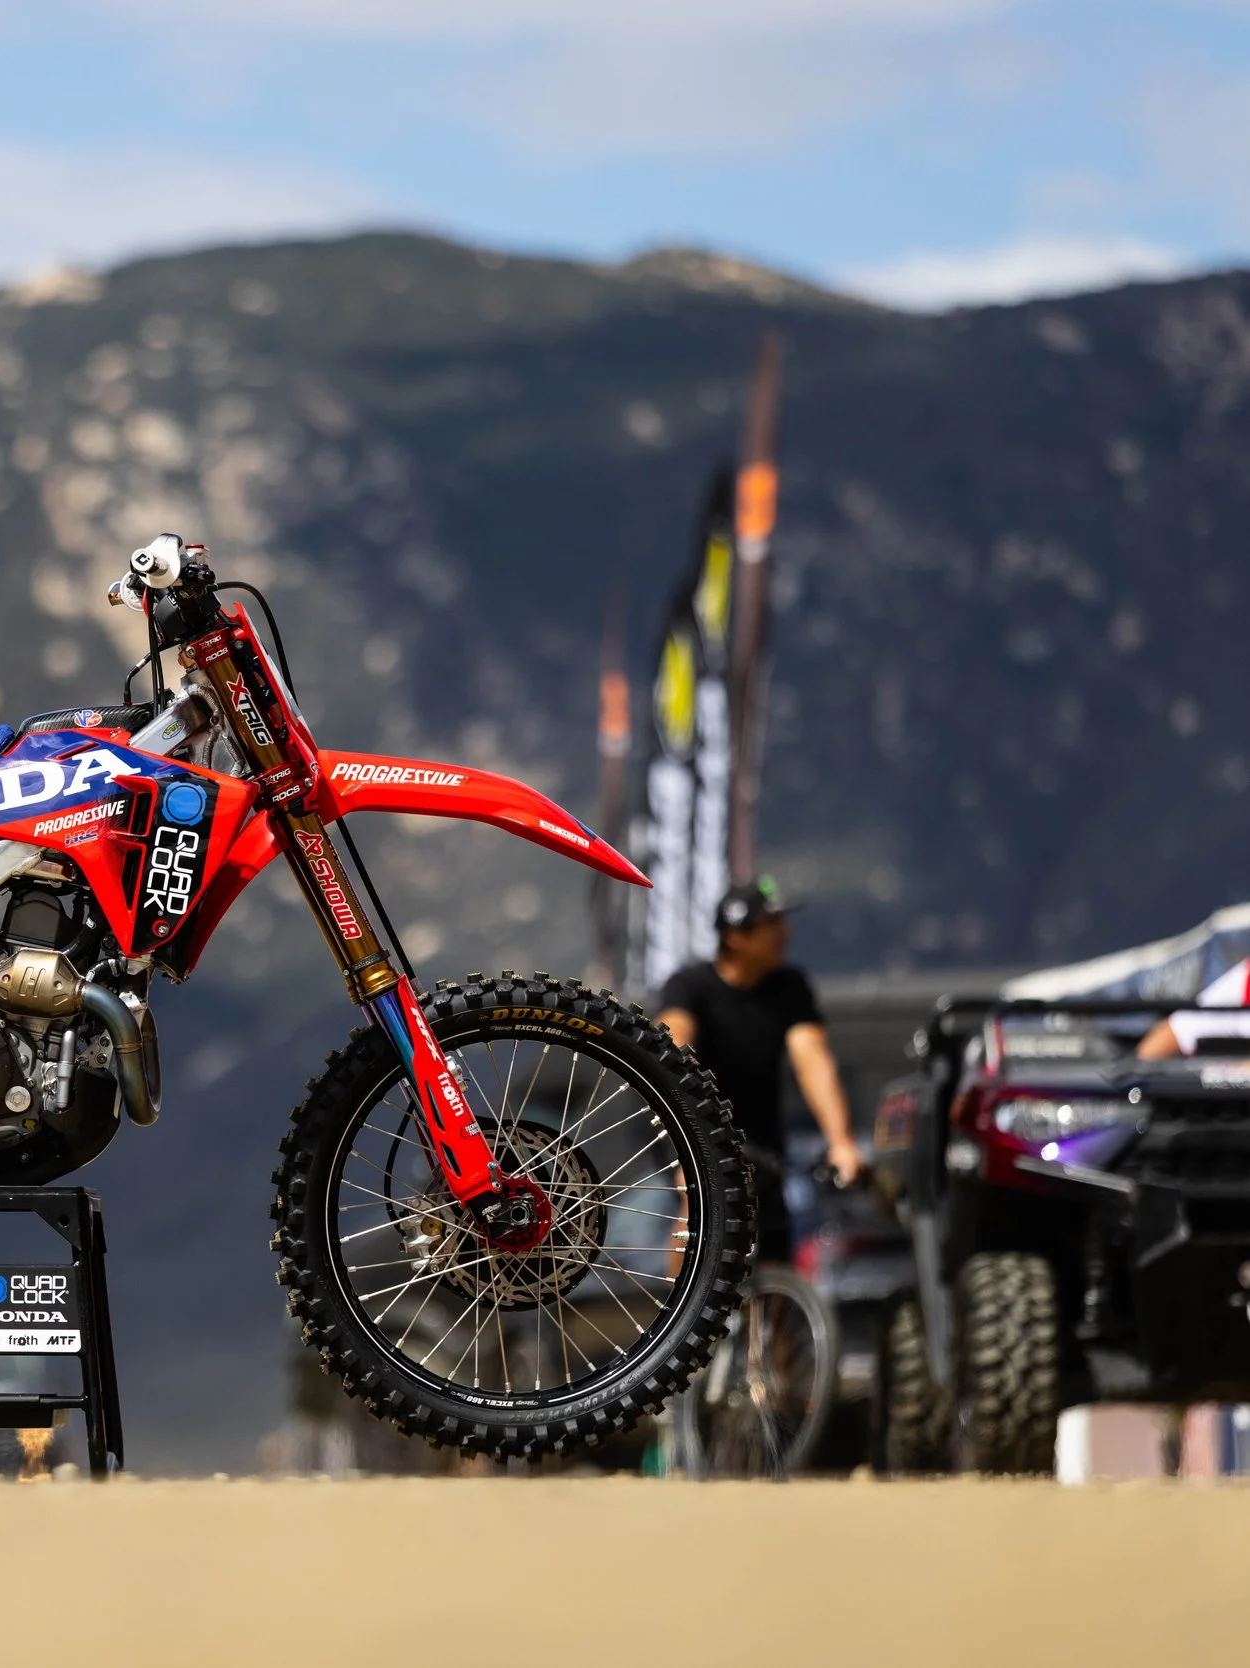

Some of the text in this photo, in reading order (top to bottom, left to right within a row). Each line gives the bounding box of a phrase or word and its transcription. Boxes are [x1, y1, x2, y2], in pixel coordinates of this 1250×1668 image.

[199, 635, 222, 649] XTRIG
[205, 647, 228, 662] ROCS
[226, 672, 273, 746] XTRIG
[262, 767, 291, 785] XTRIG
[330, 763, 467, 787] PROGRESSIVE
[272, 784, 300, 802] ROCS
[34, 800, 125, 837] PROGRESSIVE
[144, 826, 178, 911] LOCK
[166, 830, 199, 915] QUAD
[310, 859, 362, 940] SHOWA
[491, 1007, 605, 1037] DUNLOP
[514, 1024, 544, 1033] EXCEL
[437, 1071, 464, 1117] froth
[10, 1275, 67, 1290] QUAD
[10, 1290, 66, 1305] LOCK
[9, 1333, 38, 1346] froth
[46, 1336, 76, 1345] MTF
